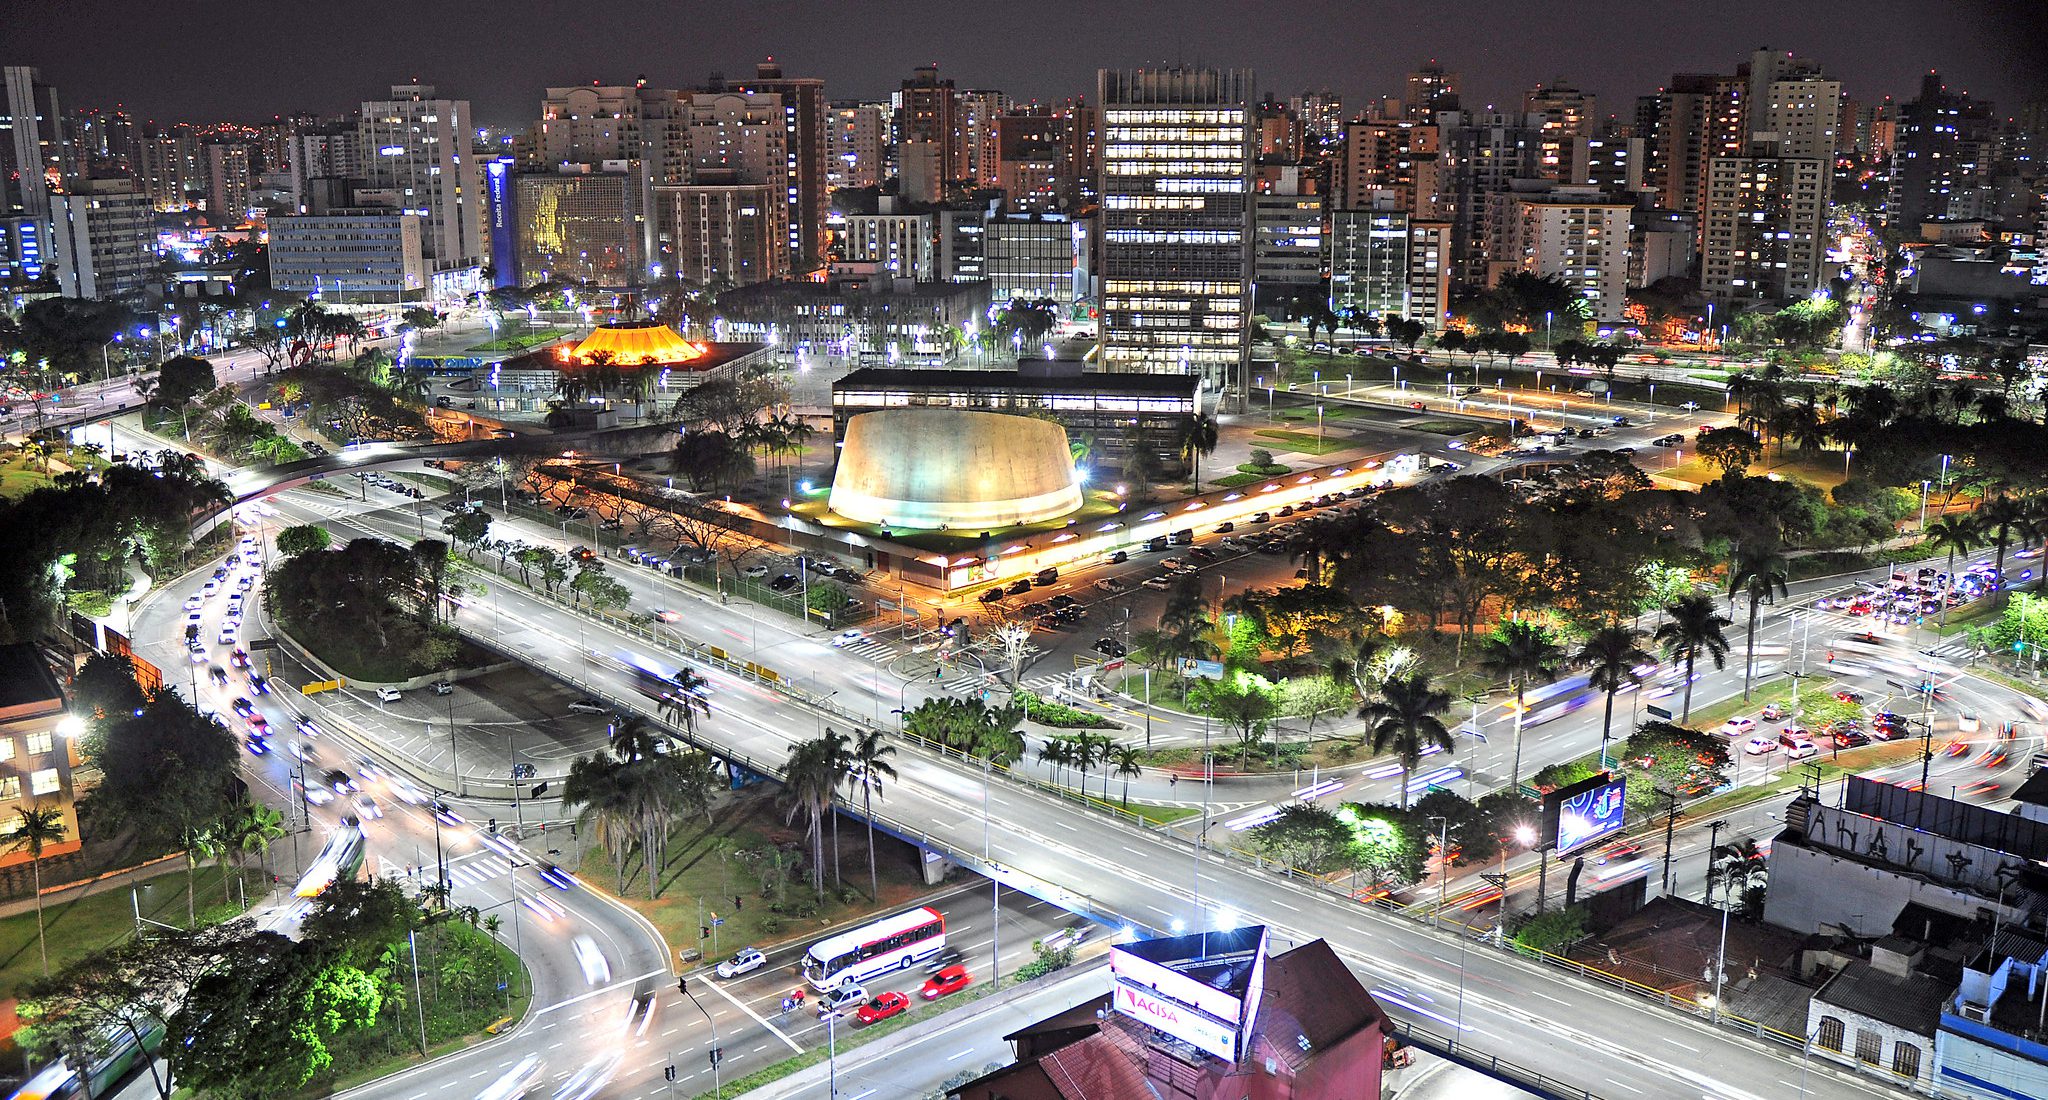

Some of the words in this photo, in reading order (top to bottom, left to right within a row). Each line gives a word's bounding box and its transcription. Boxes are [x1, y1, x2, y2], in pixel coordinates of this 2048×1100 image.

[493, 177, 501, 203] Federal
[495, 203, 503, 228] Receita
[1137, 998, 1178, 1024] ACISA
